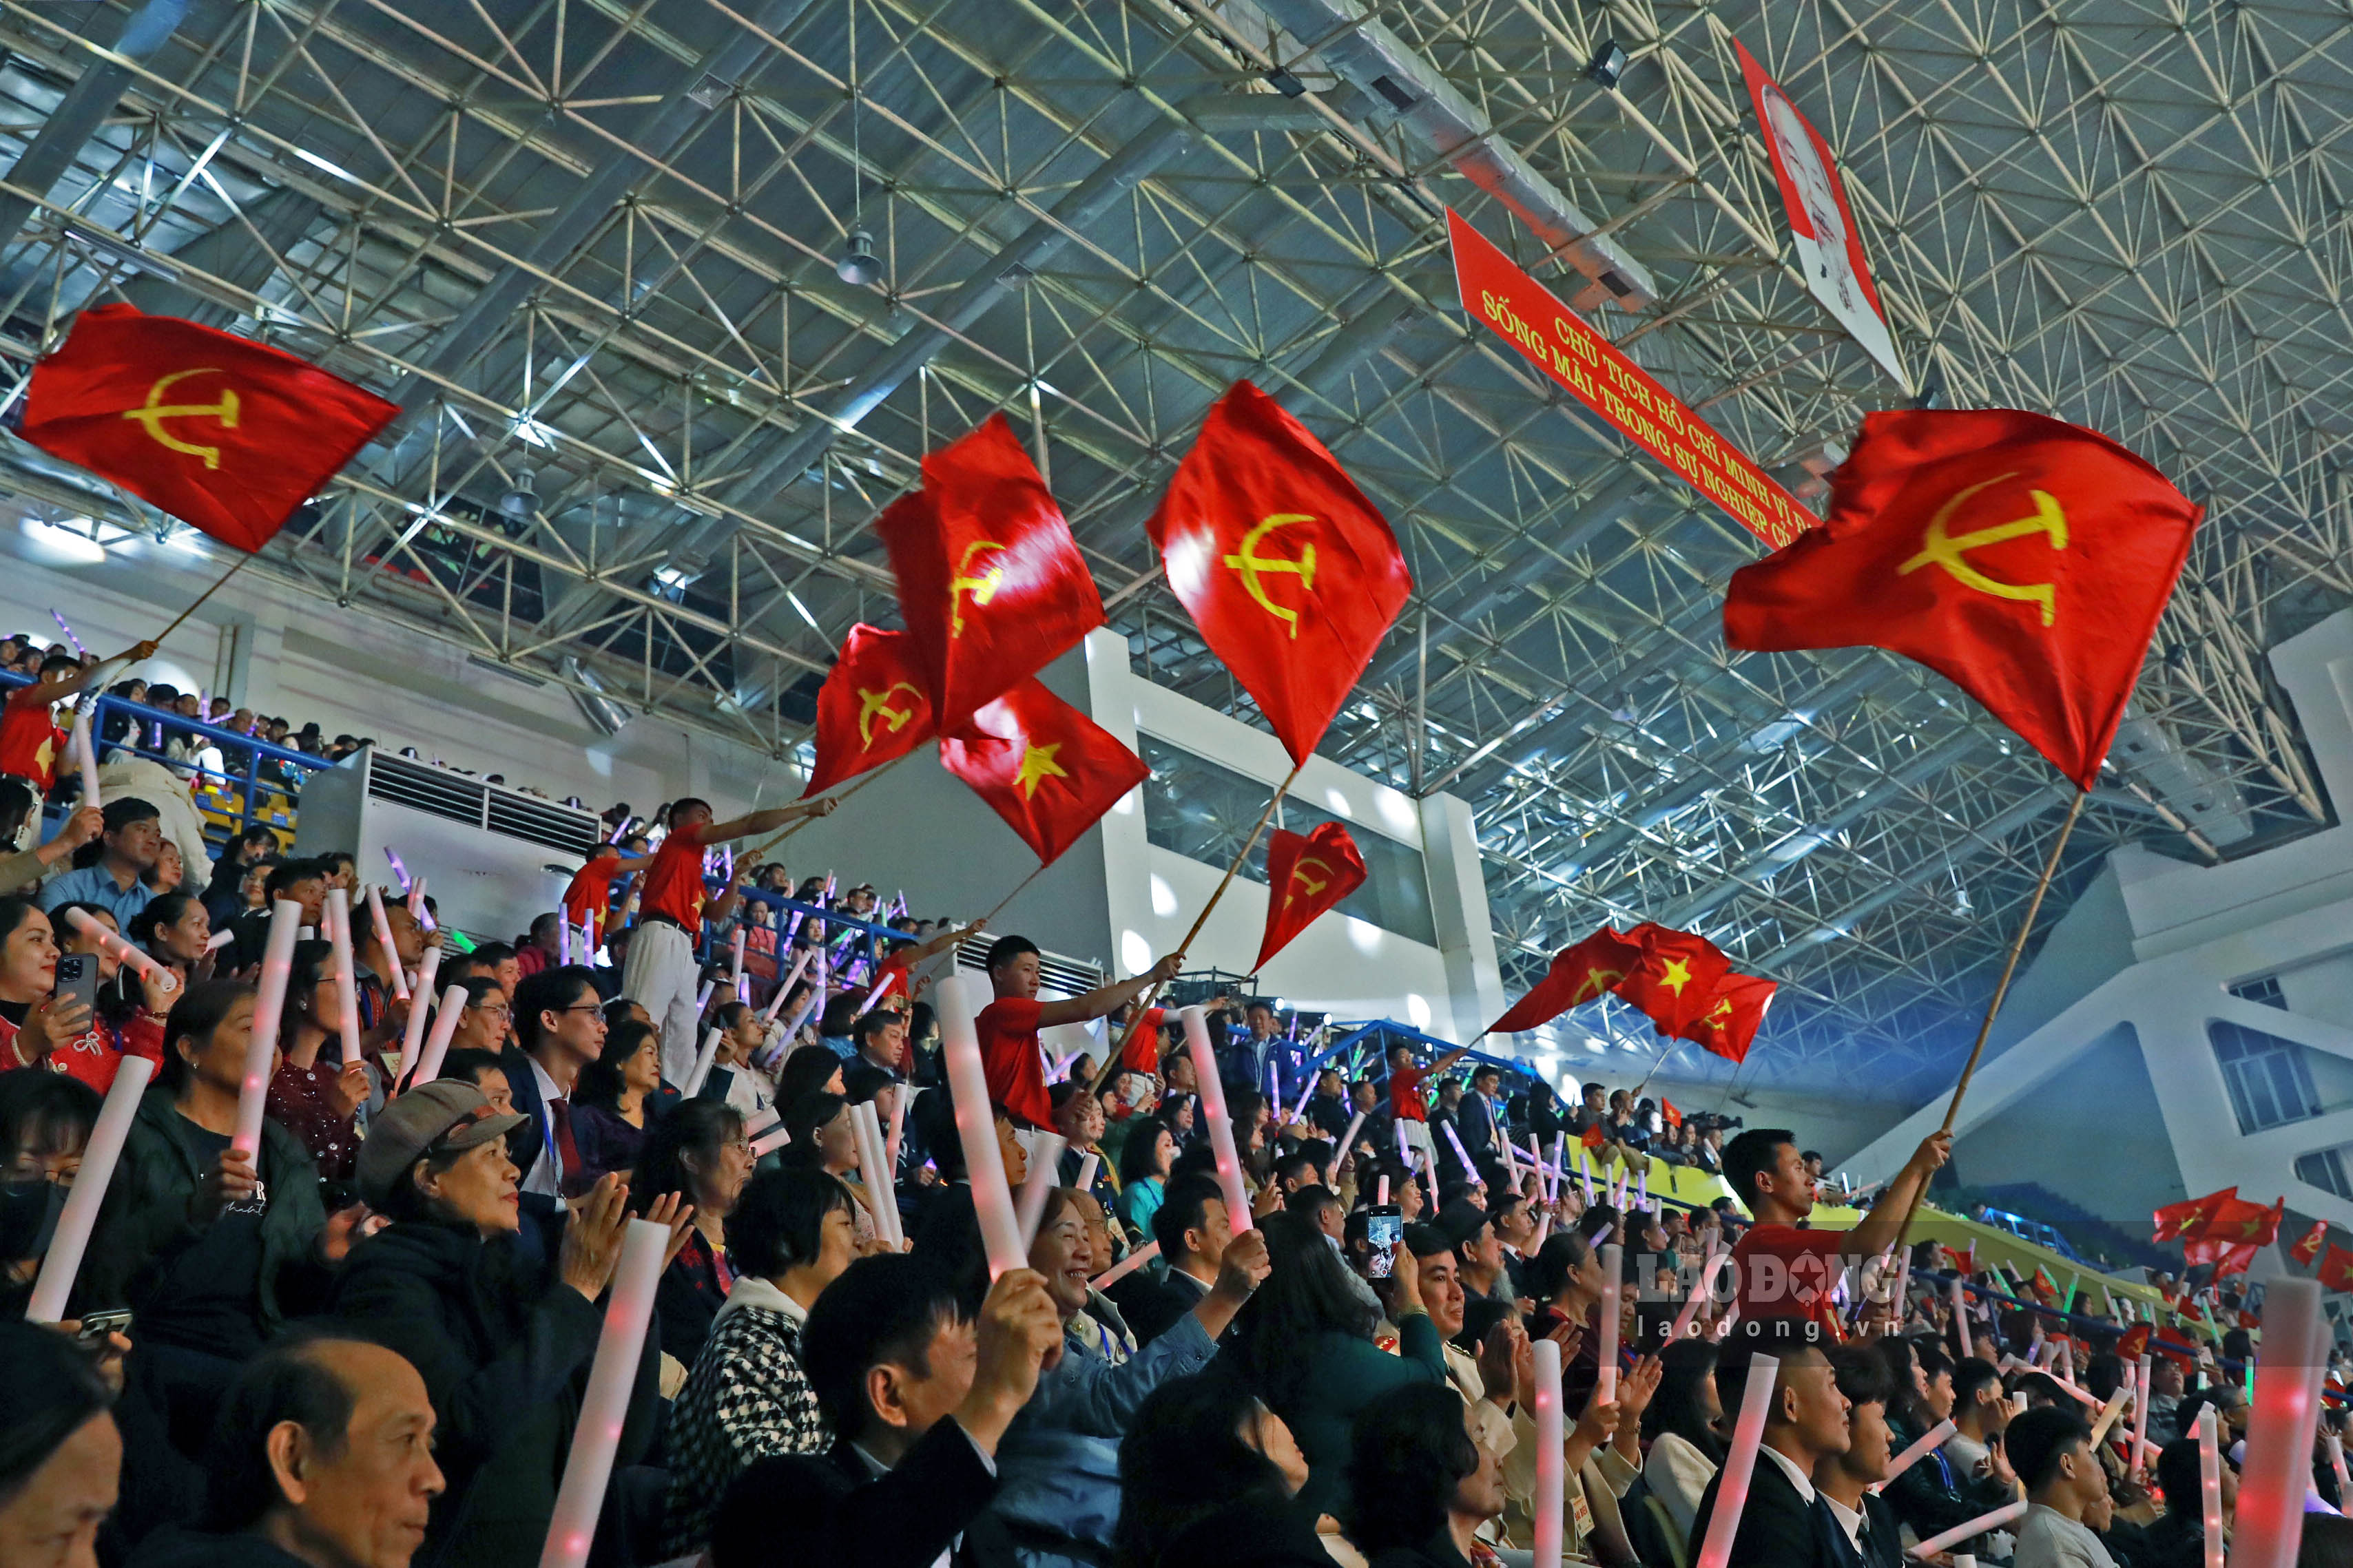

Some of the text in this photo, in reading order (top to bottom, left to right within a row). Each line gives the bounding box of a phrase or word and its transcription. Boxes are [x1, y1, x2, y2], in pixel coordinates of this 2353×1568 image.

[1482, 290, 1548, 362] SỐNG
[1599, 384, 1671, 458] TRONG
[1674, 443, 1699, 484] SỰ
[1700, 463, 1768, 534] NGHIỆP
[1555, 317, 1599, 368] CHỦ
[1602, 355, 1654, 413] TỊCH
[1655, 396, 1685, 436] HỒ
[1688, 424, 1721, 466] CHÍ
[1722, 451, 1772, 508] MINH
